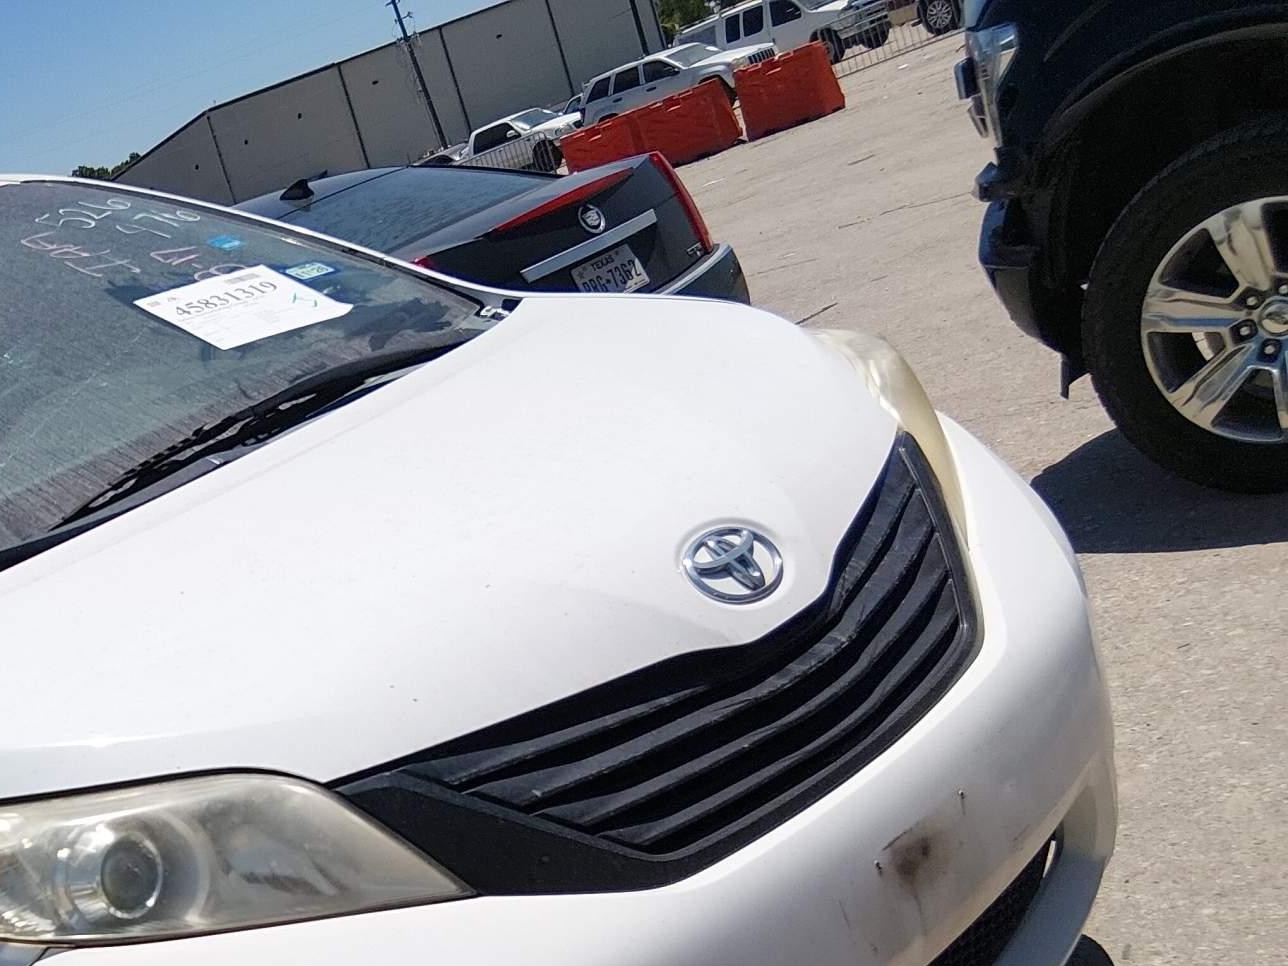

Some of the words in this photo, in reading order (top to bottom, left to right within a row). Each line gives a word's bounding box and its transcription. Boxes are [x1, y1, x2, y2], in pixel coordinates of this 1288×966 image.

[36, 198, 131, 229] 526
[591, 255, 615, 271] TEXAS
[175, 281, 278, 317] 45831319
